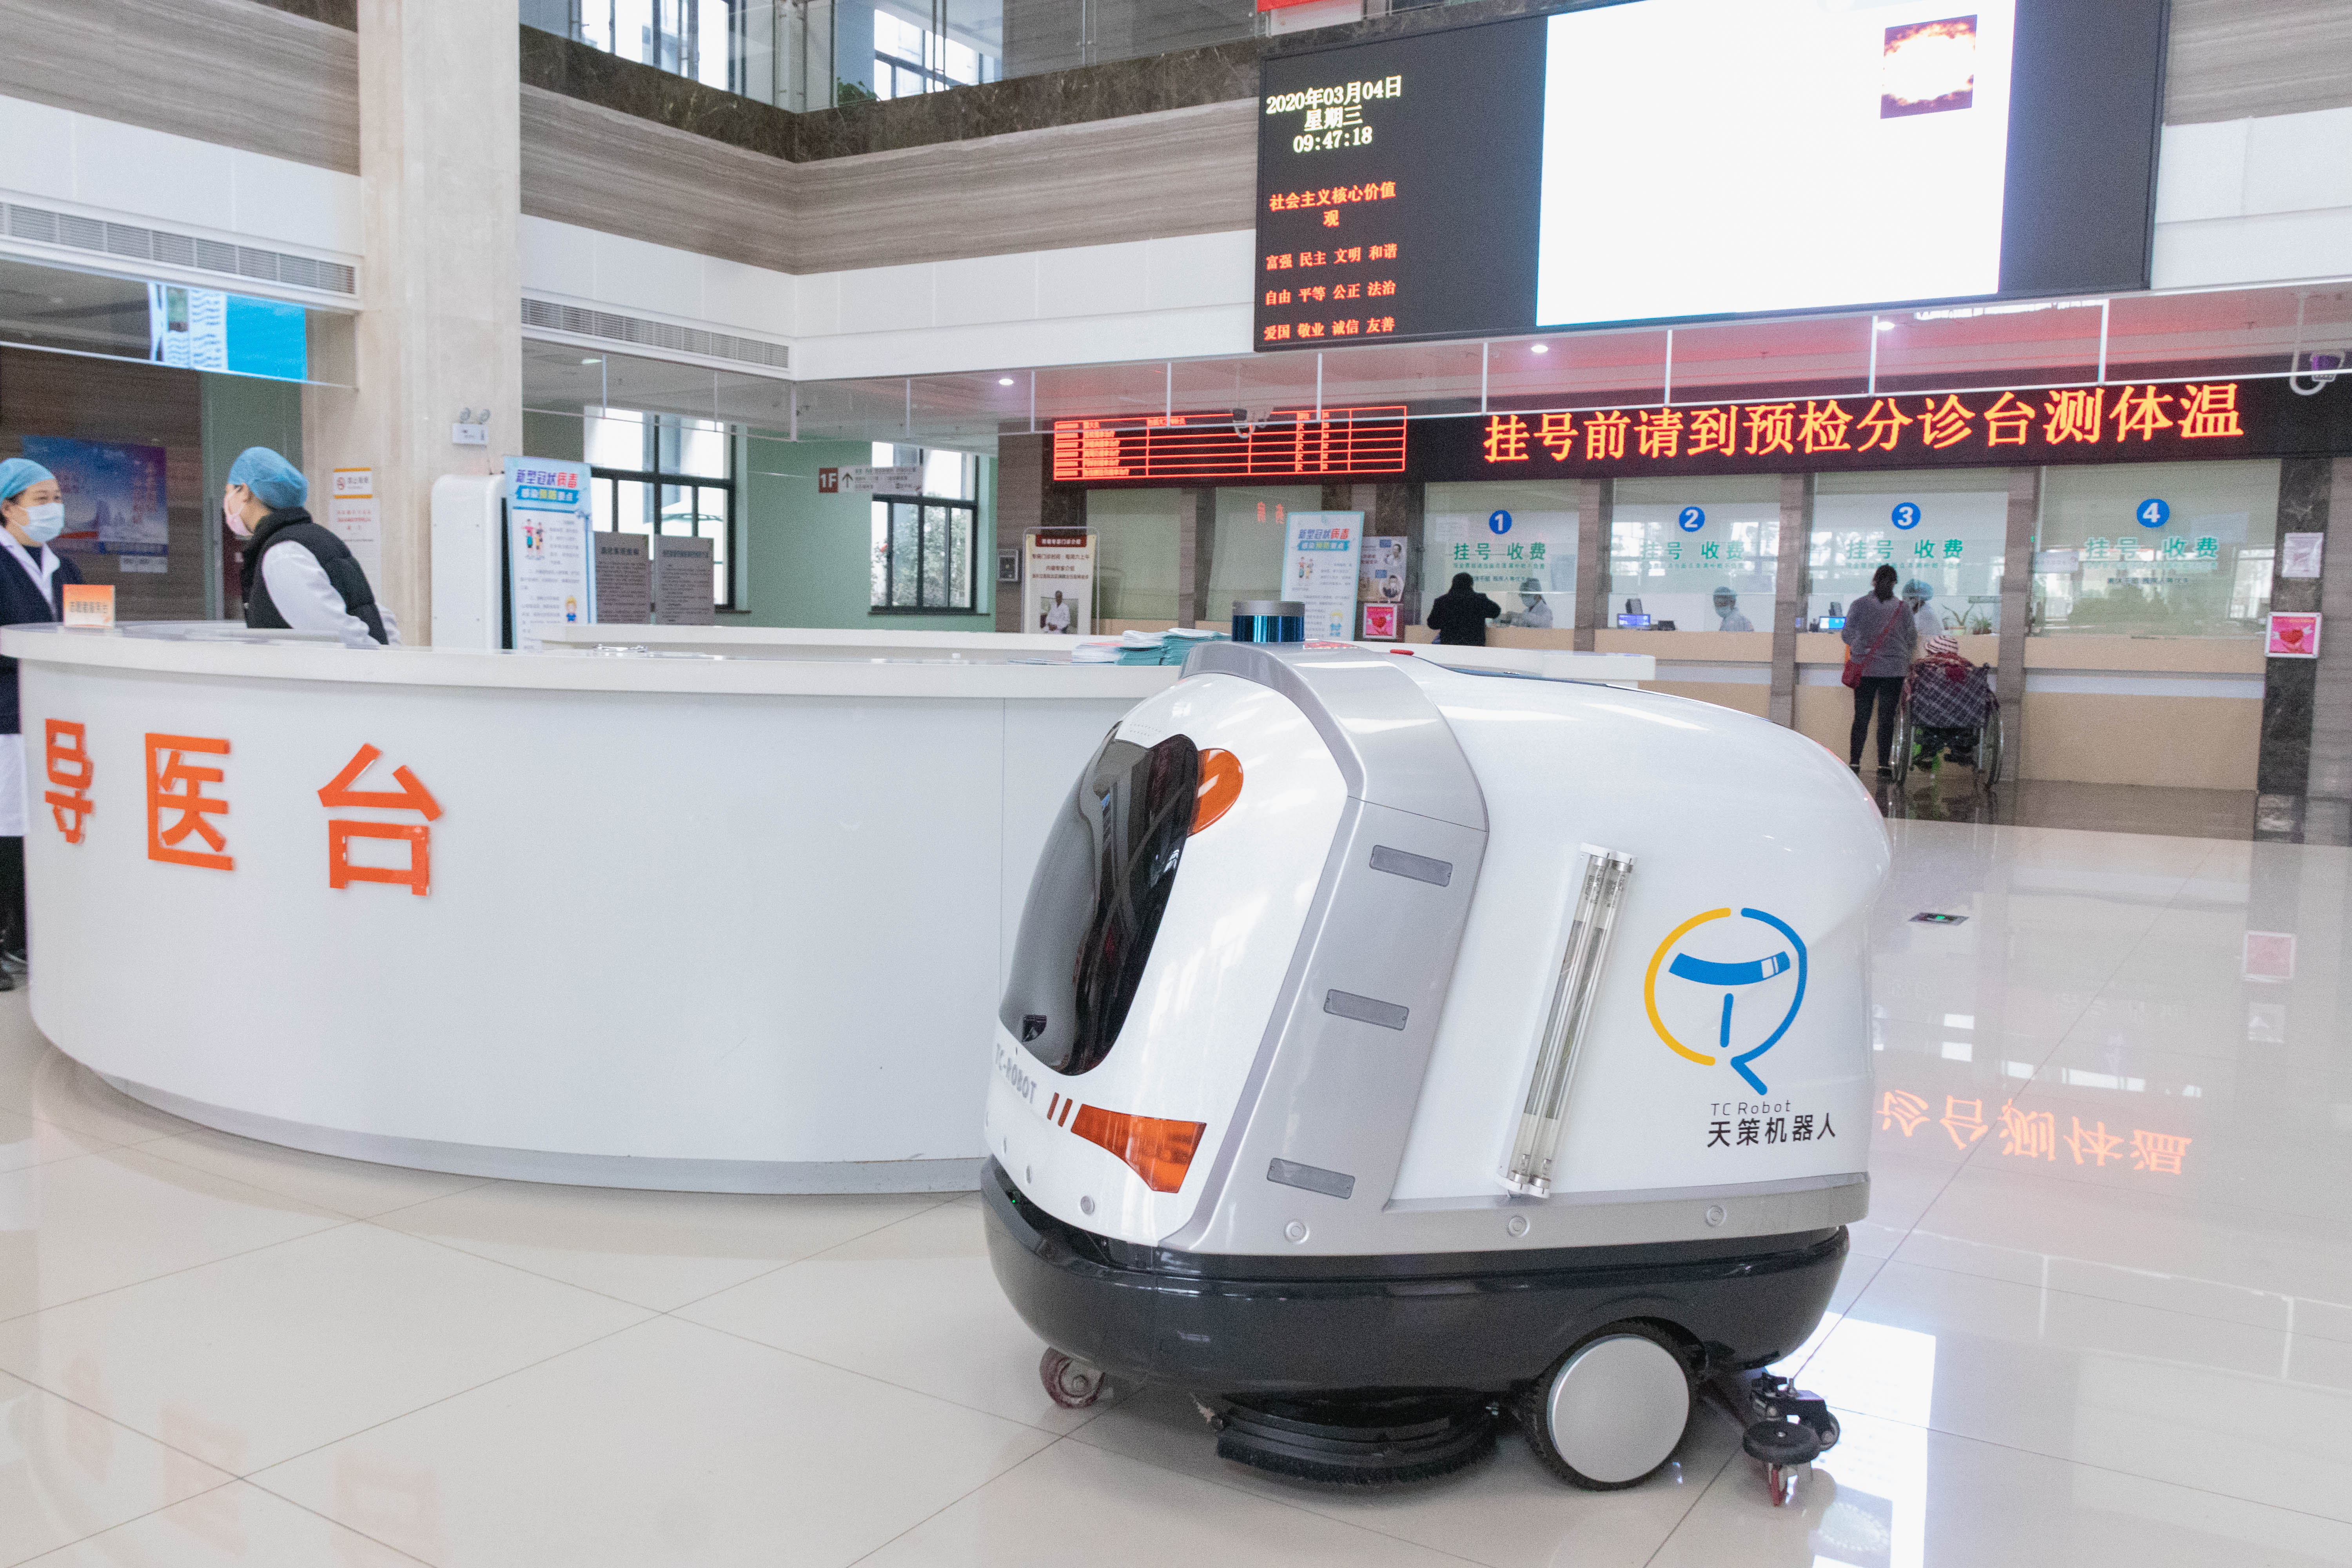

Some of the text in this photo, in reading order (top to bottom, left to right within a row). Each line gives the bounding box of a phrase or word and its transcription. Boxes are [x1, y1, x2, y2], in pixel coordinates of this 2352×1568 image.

[1266, 75, 1402, 114] 2020年03月04日
[1304, 104, 1363, 131] 星期三
[1293, 126, 1372, 153] 09:47:18
[1269, 181, 1396, 211] 社会主义核心价值
[1323, 210, 1339, 227] 观
[1266, 243, 1398, 270] 富强 民主 文明 和谐
[1265, 280, 1396, 306] 自由 平等 公正 法治
[1264, 316, 1395, 341] 爱国 敬业 诚信 友善
[1483, 383, 2244, 463] 挂号前请到预检分诊台测体温
[820, 472, 837, 489] 1F
[1494, 514, 1504, 532] 1
[1685, 509, 1698, 528] 2
[1898, 506, 1914, 525] 3
[2142, 503, 2161, 523] 4
[1454, 542, 1546, 560] 挂号 收费
[1640, 540, 1744, 560] 挂号 收费
[1846, 539, 1963, 559] 挂号 收费
[2085, 535, 2218, 559] 挂号 收费
[45, 718, 443, 897] 导医台
[1711, 1099, 1791, 1116] TC Robot
[1707, 1112, 1836, 1148] 天策机器人
